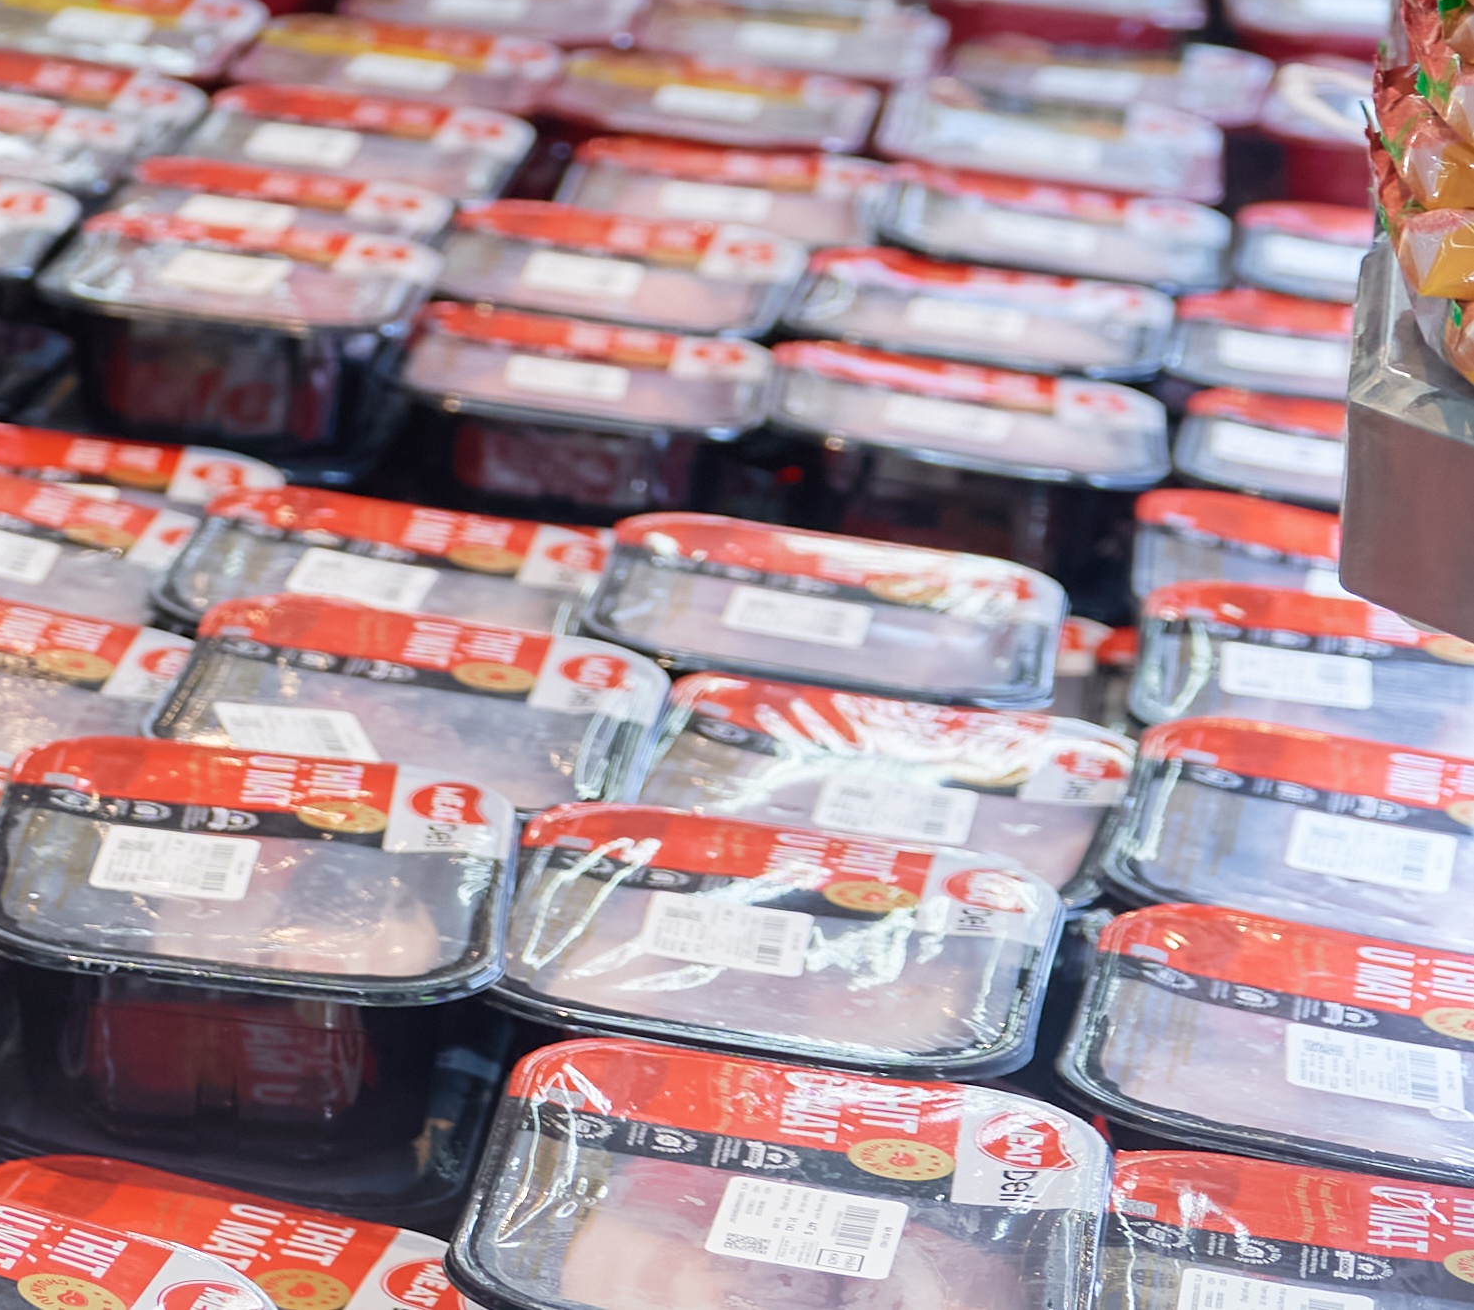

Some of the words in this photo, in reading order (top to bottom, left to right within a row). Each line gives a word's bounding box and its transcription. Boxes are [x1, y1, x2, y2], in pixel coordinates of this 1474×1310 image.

[1357, 946, 1430, 966] Ủ
[1354, 962, 1426, 1010] MÁT
[1000, 1168, 1038, 1205] Deli
[230, 1202, 293, 1226] Ủ
[1366, 1203, 1444, 1252] MÁT
[41, 1228, 128, 1278] THỊT
[202, 1219, 281, 1273] MÁT
[276, 1220, 356, 1266] THỊT
[402, 1258, 452, 1309] MEAT
